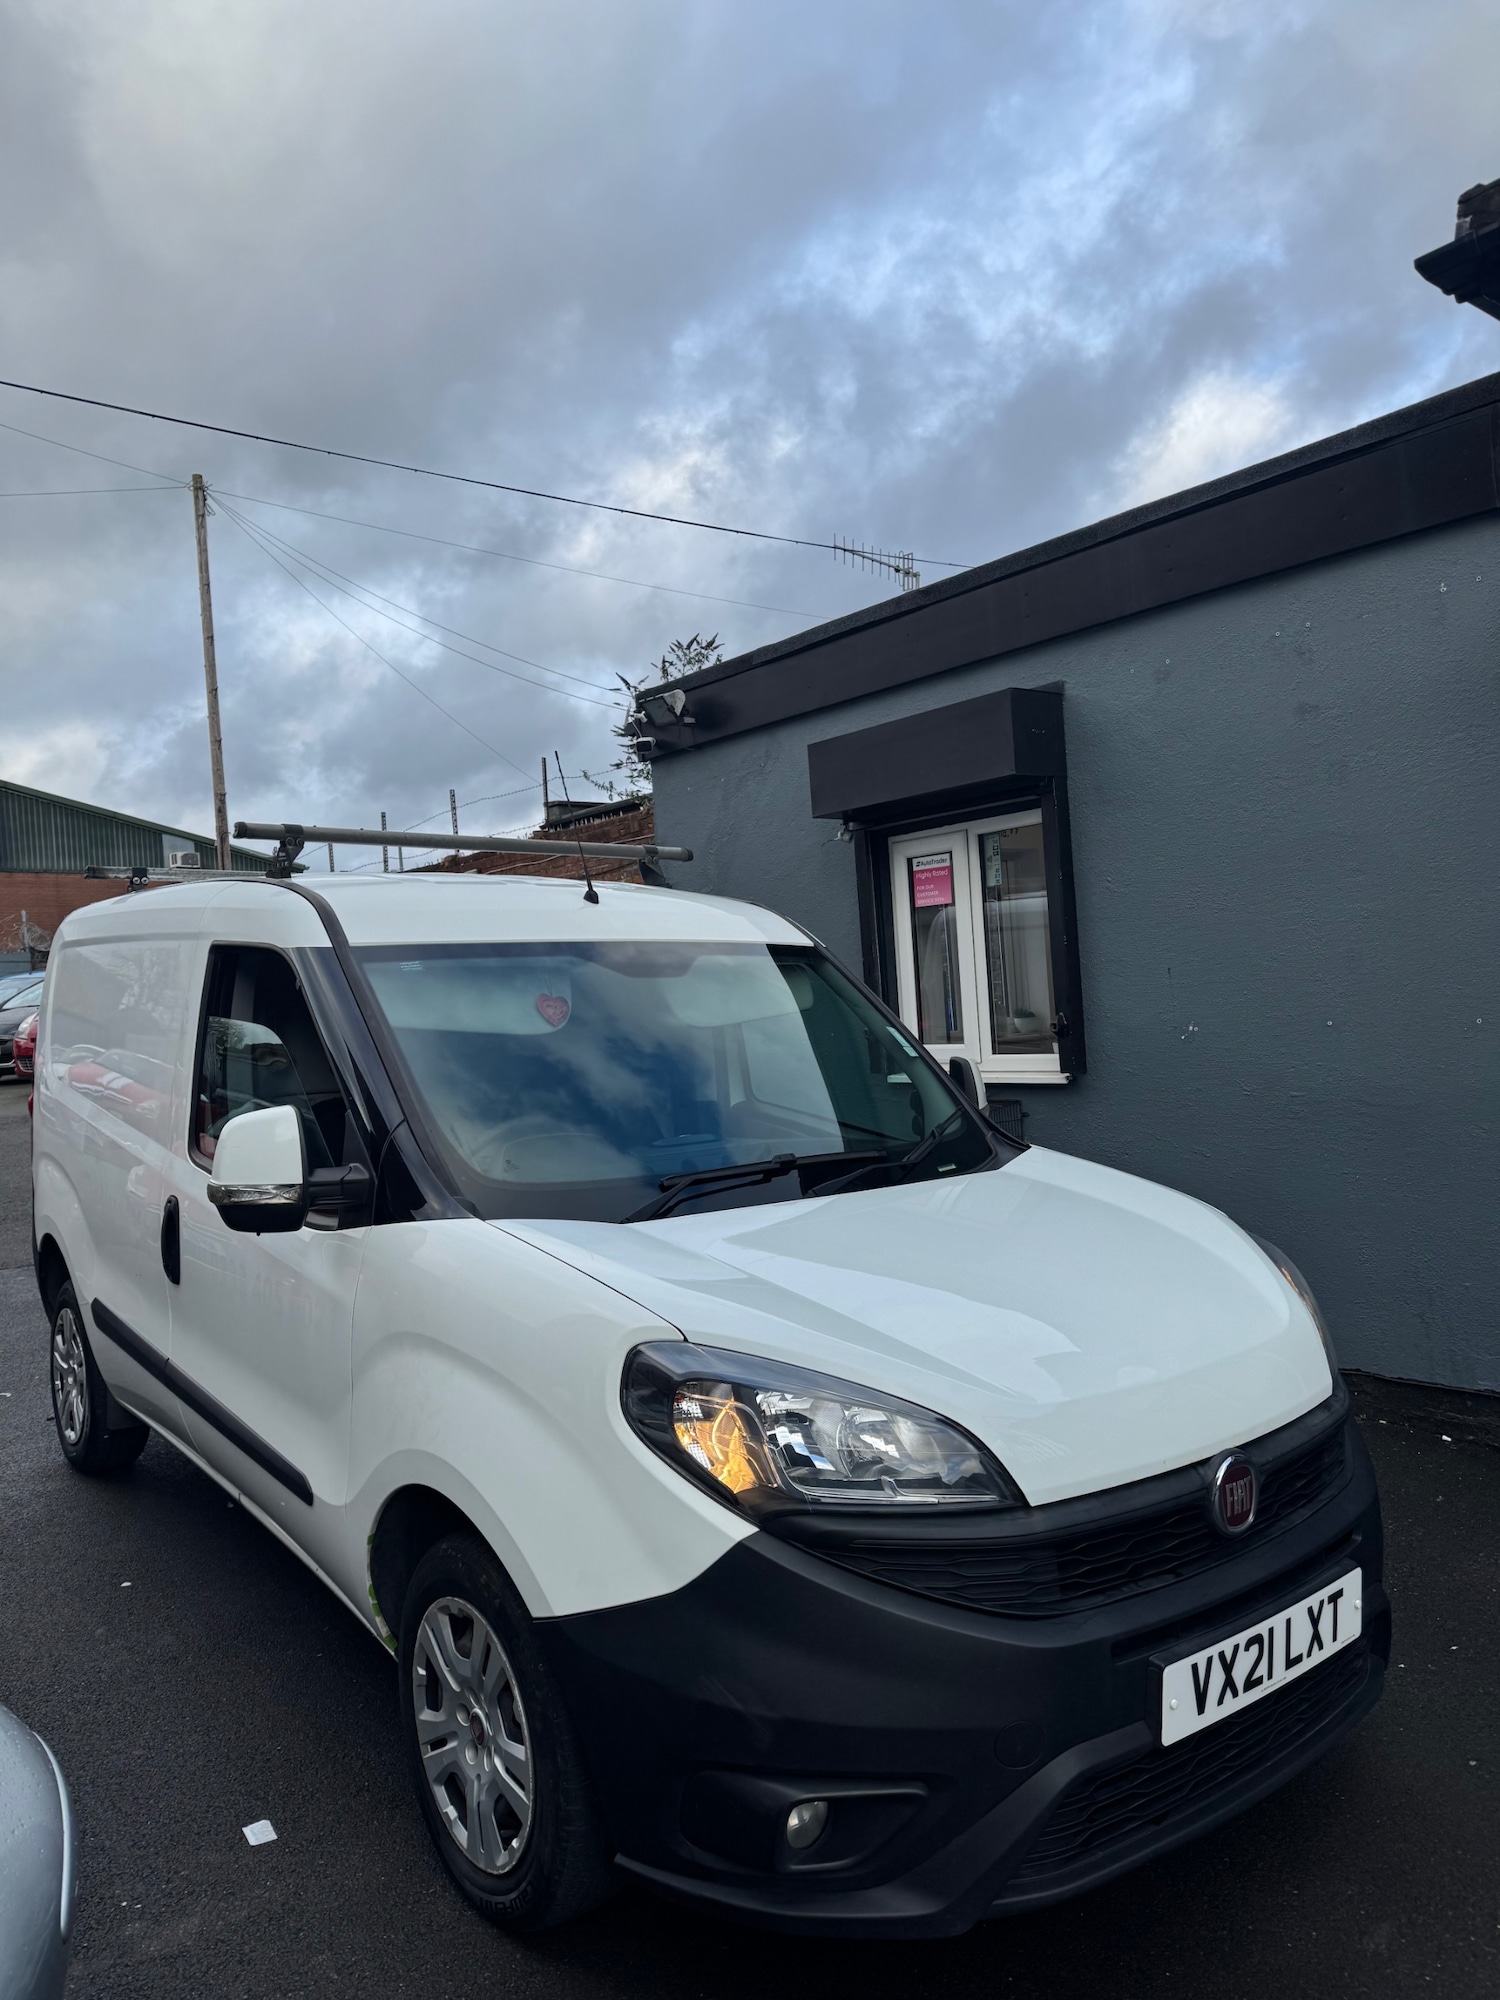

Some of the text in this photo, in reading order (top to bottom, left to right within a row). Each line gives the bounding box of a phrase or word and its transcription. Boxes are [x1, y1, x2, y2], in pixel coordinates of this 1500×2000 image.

[916, 869, 948, 880] Highly Rated
[921, 858, 948, 866] AutoTrader
[1225, 1475, 1252, 1518] FIAT
[1190, 1587, 1344, 1717] VX21 LXT
